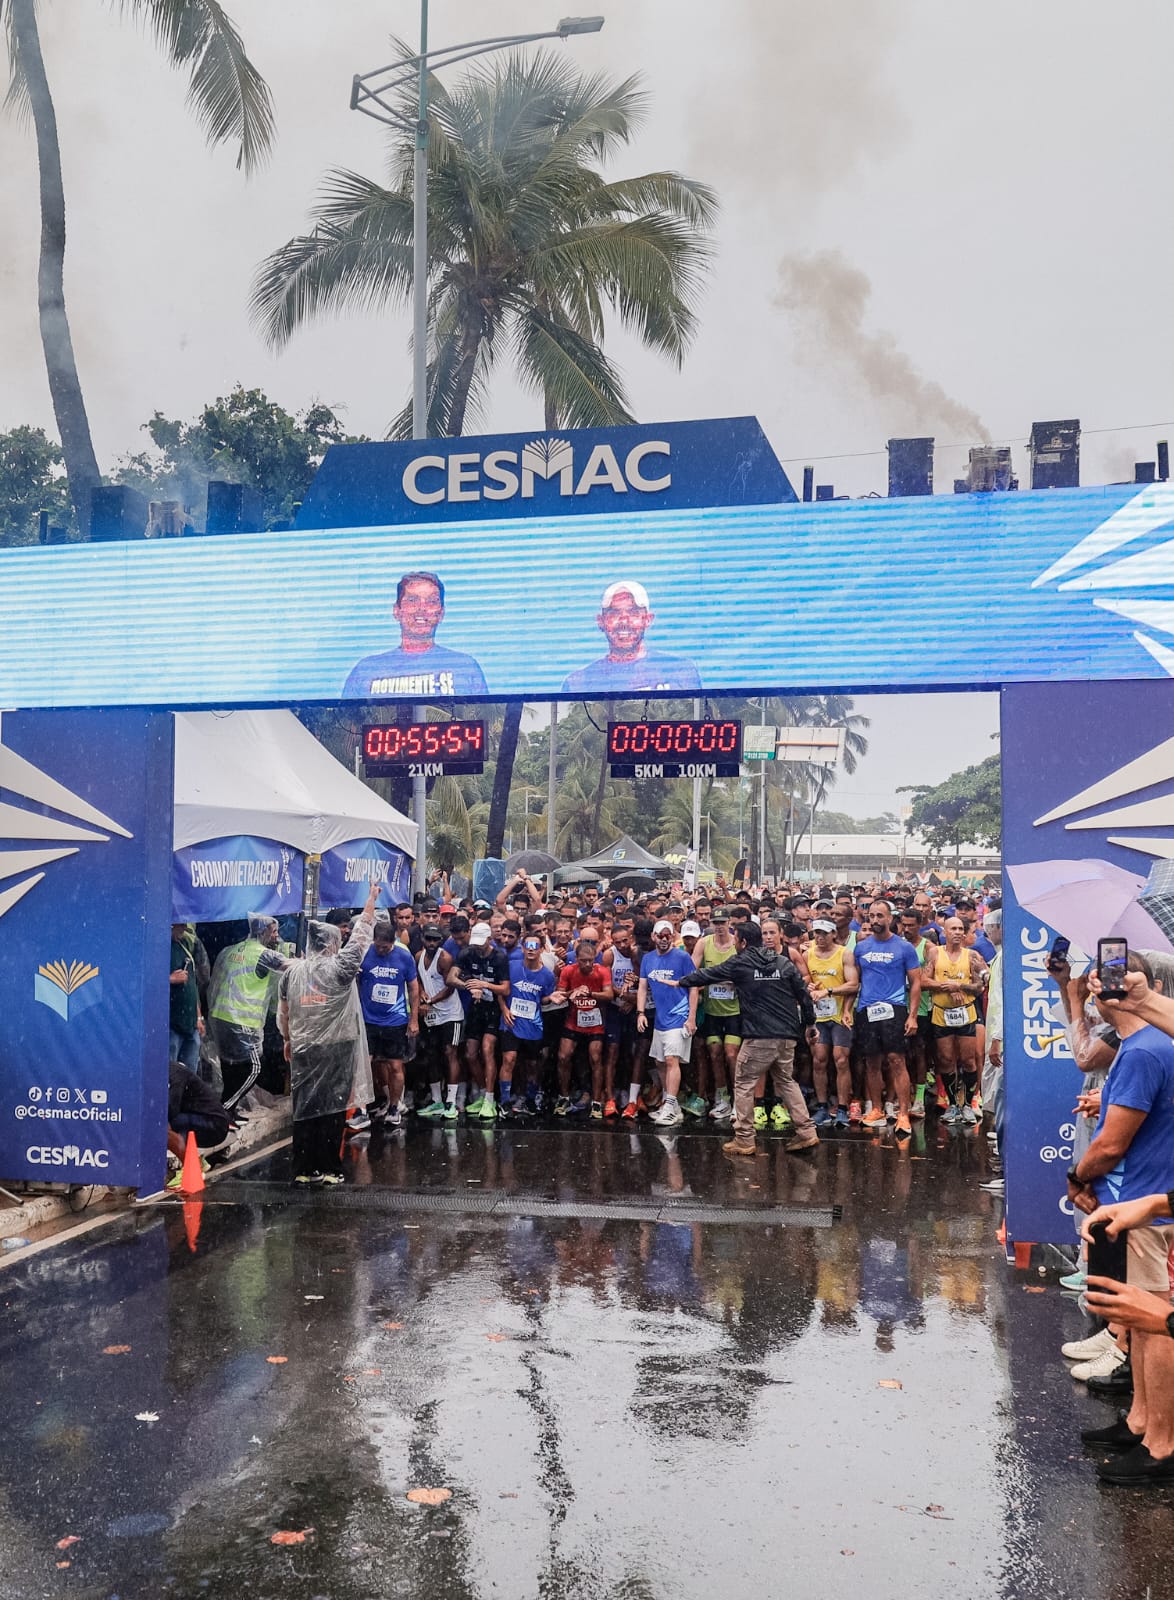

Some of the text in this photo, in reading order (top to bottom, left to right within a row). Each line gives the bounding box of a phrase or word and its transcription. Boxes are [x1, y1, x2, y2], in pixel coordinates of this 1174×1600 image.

[402, 437, 672, 505] CESMAC
[366, 723, 482, 756] 00:55:54
[612, 723, 737, 753] 00:00:00
[408, 763, 444, 778] 21KM
[634, 764, 717, 778] 5KM 10KM
[190, 860, 280, 888] CRONOMETRAGEM
[1021, 927, 1051, 1059] CESMAC
[14, 1104, 122, 1122] @CesmacOficial
[26, 1144, 109, 1168] CESMAC
